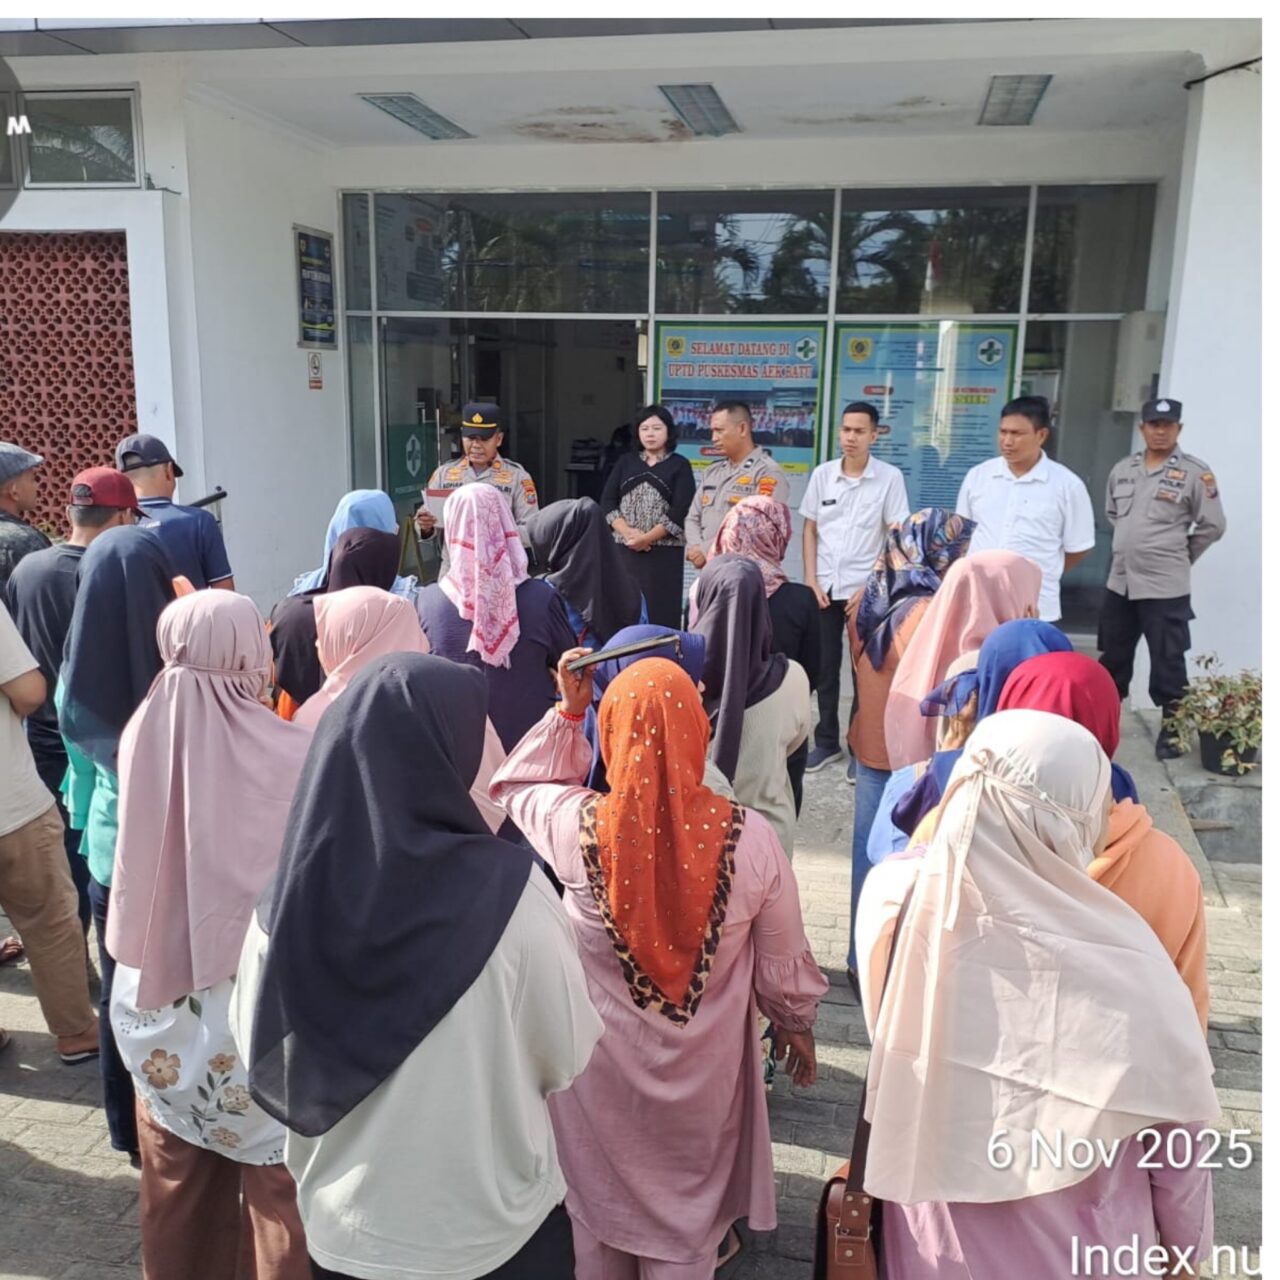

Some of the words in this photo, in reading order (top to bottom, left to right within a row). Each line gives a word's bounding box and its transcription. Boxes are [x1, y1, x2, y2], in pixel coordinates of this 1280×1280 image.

[691, 342, 735, 356] SELAMAT
[738, 343, 776, 356] DATANG
[779, 344, 790, 356] DI
[668, 363, 694, 377] UPTD
[697, 364, 758, 378] PUSKESMAS
[761, 364, 782, 378] AEK
